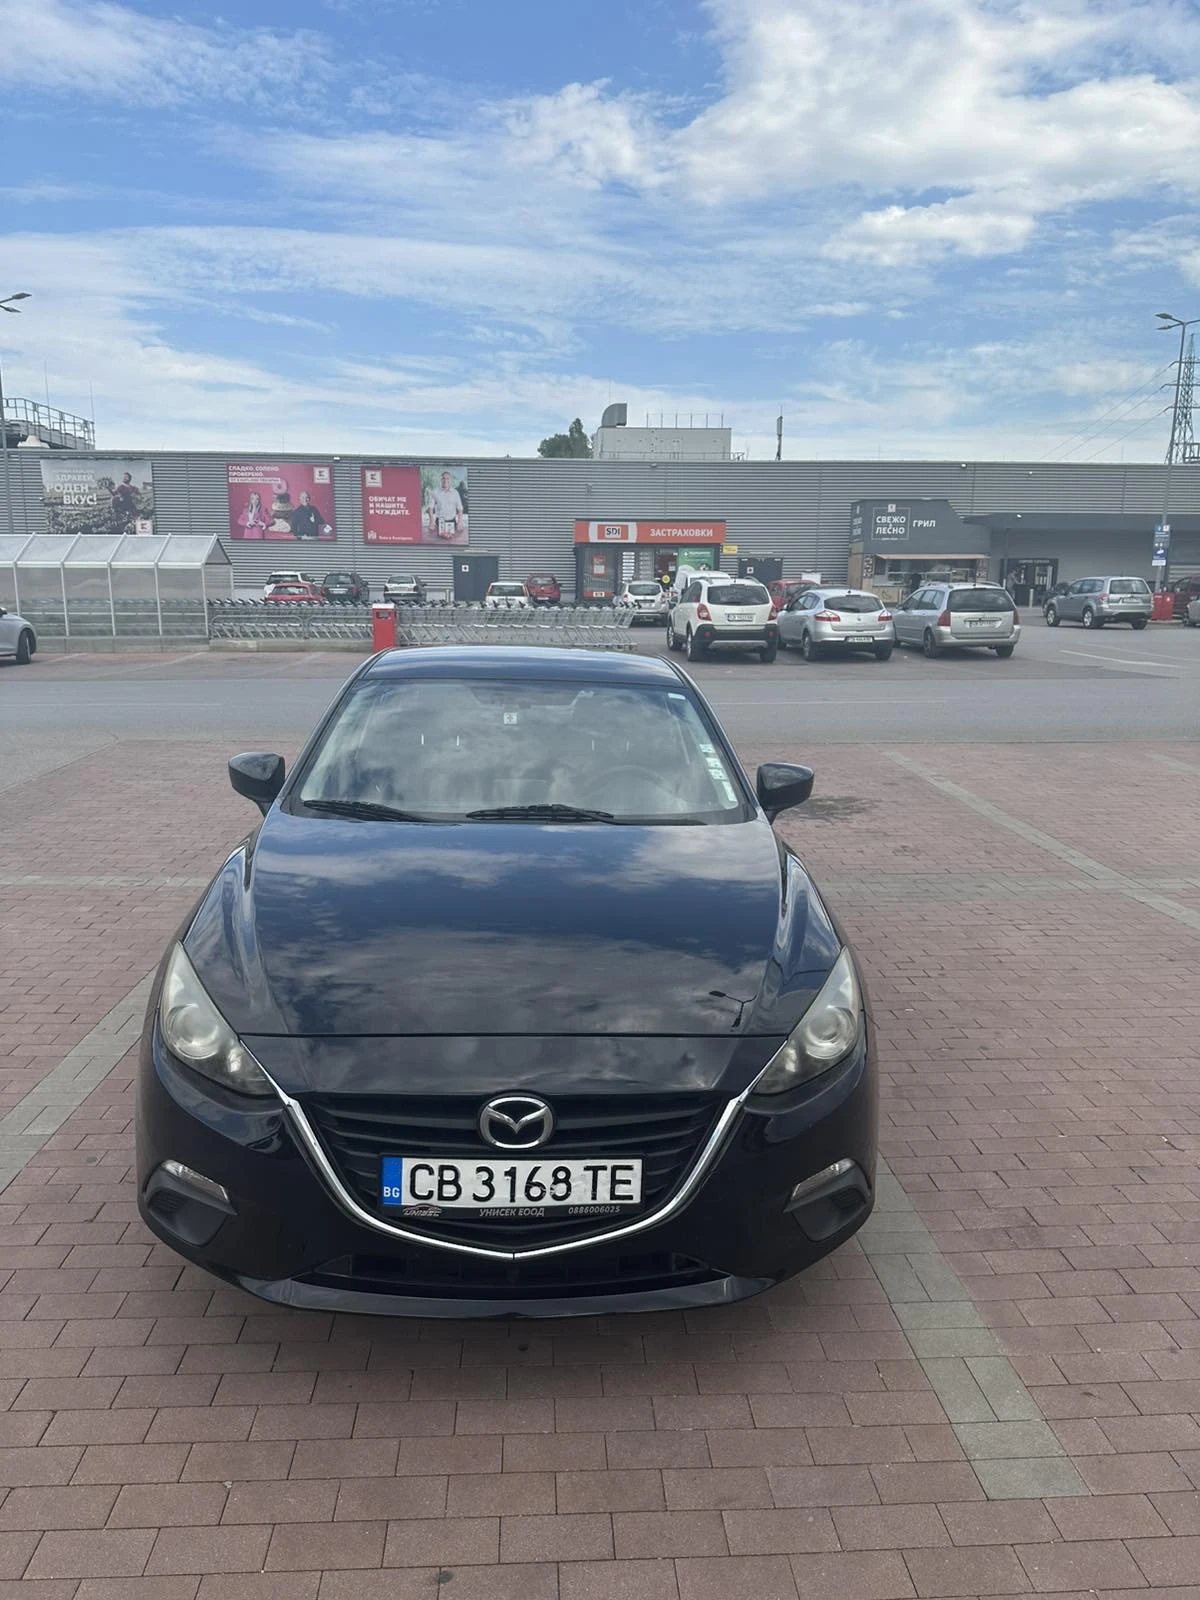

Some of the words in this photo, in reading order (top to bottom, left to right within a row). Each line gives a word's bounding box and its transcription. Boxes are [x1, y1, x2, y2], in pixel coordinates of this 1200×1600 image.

[63, 493, 97, 505] ВКУС!
[876, 515, 906, 523] СВЕЖО
[606, 527, 621, 536] SDI
[650, 528, 713, 537] ЗАСТРАХОВКИ
[410, 1163, 462, 1202] CB
[472, 1165, 572, 1203] 3168
[583, 1164, 634, 1201] TE
[383, 1186, 400, 1198] BG
[479, 1208, 516, 1217] УНИСЕК
[518, 1207, 545, 1217] ЕООД
